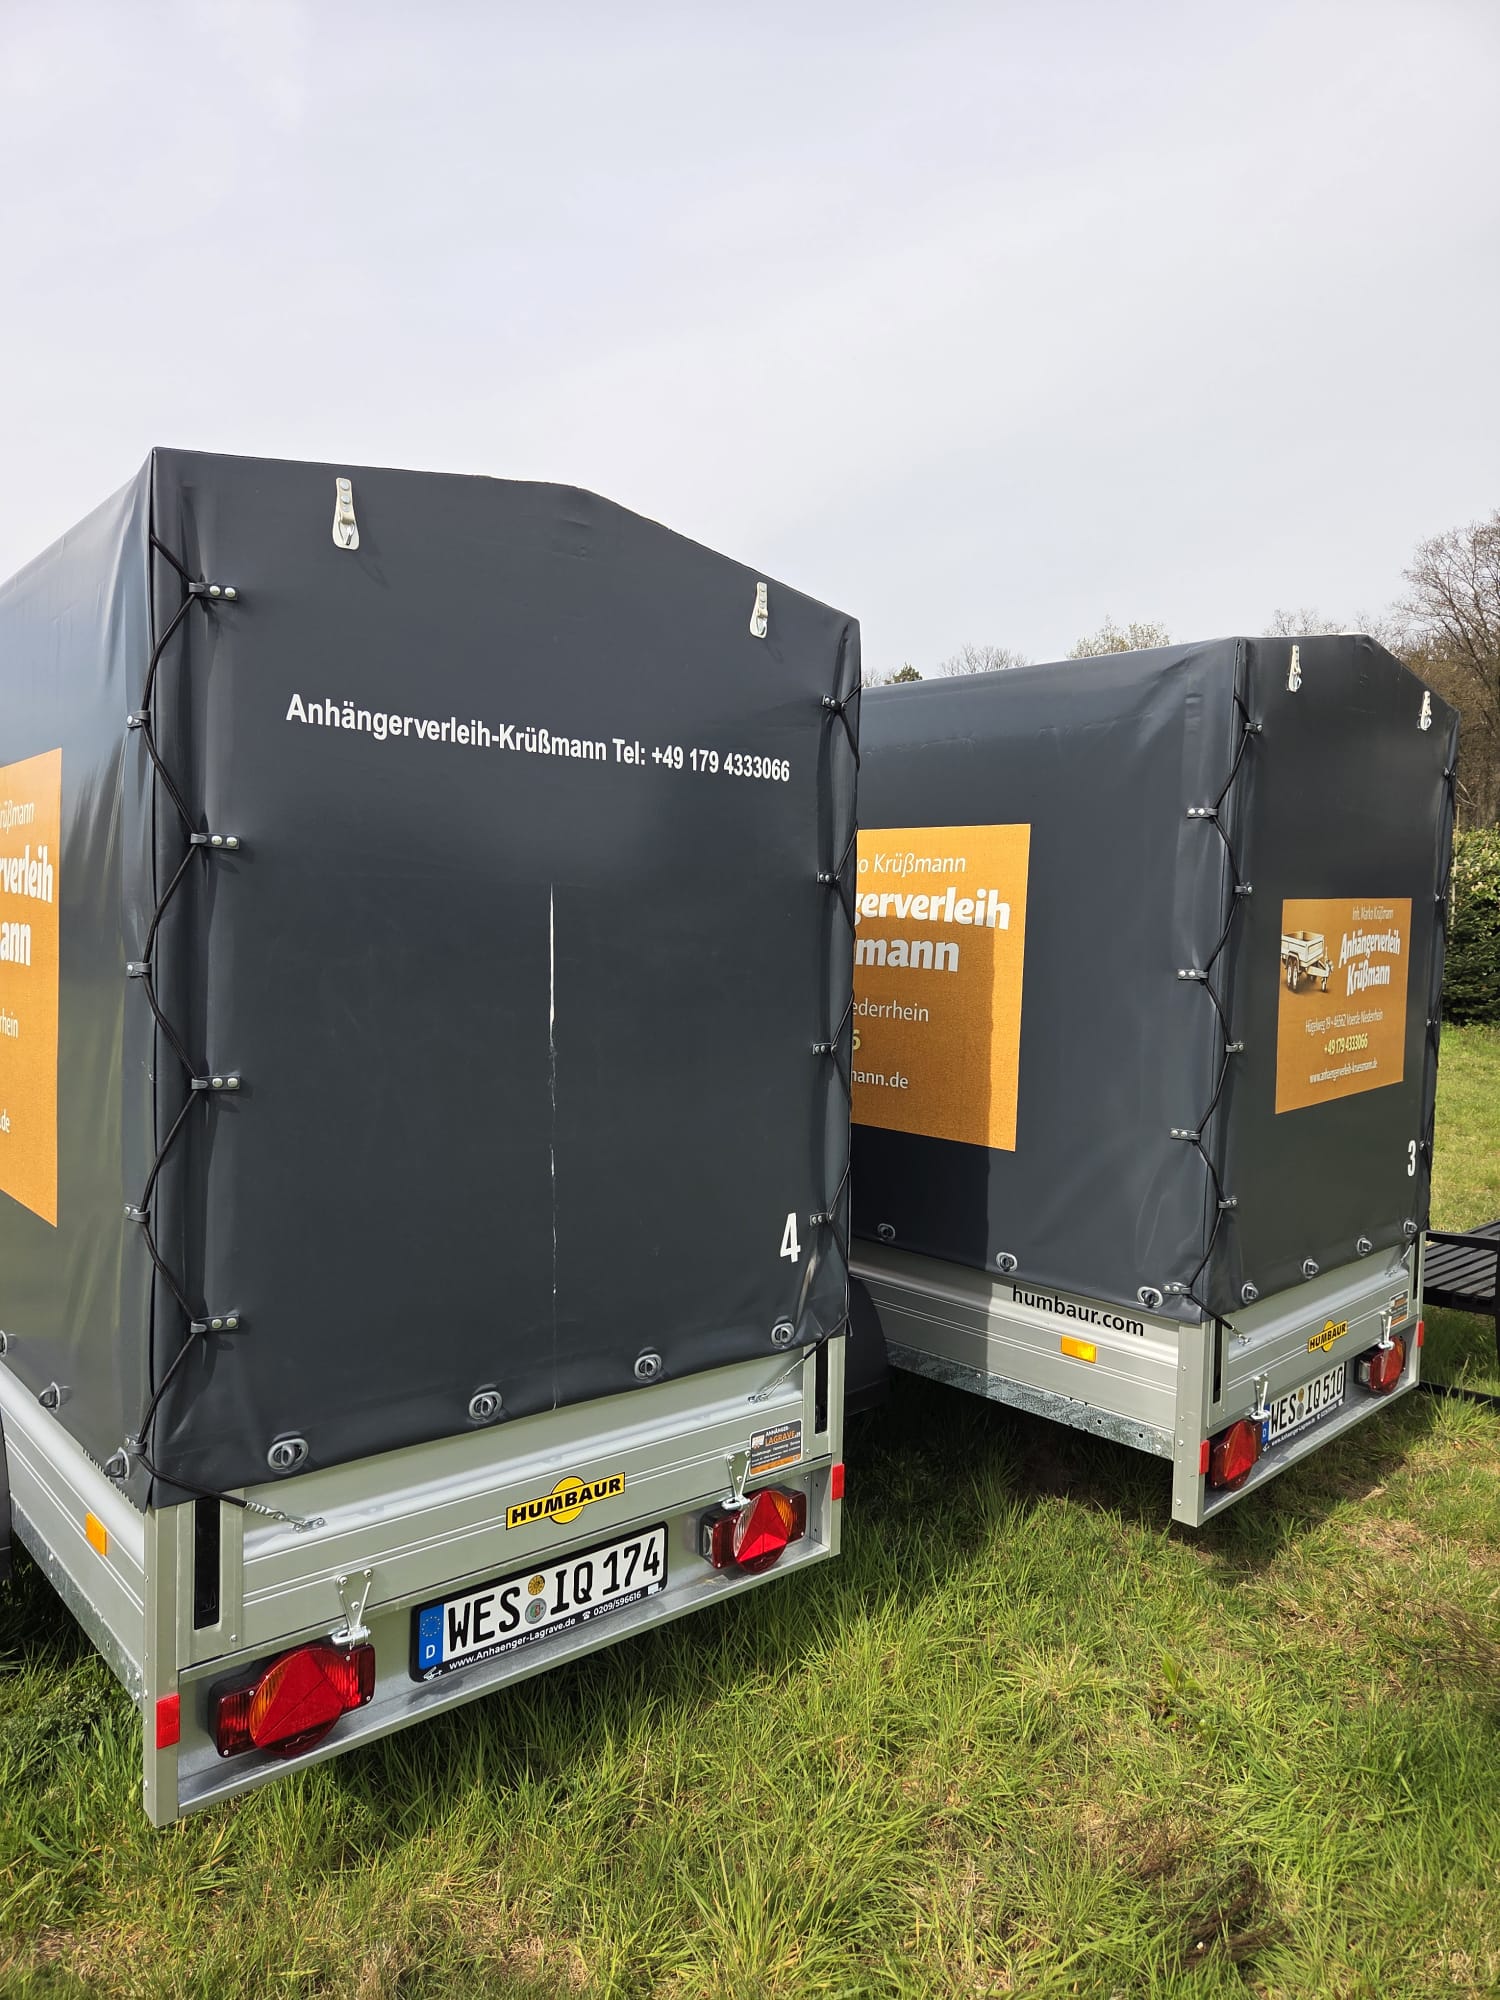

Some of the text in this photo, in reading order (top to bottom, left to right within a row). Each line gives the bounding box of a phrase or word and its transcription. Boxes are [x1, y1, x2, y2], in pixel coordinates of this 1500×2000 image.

[286, 693, 790, 782] Anhängerverleih-Krüßmann Tel: +49 179 4333066
[873, 852, 967, 878] Krüßmann
[1338, 928, 1401, 969] Anhängerverleih
[1346, 959, 1391, 997] Krüßmann
[1345, 1033, 1368, 1052] 4333066
[1407, 1139, 1417, 1177] 3
[780, 1212, 802, 1263] 4
[1012, 1284, 1144, 1337] humbaur.com
[1309, 1323, 1347, 1350] HUMBAUR
[1271, 1366, 1343, 1435] WES IQ 510
[511, 1477, 622, 1525] HUMBAUR
[447, 1536, 660, 1653] WES IQ 174
[425, 1644, 436, 1660] D
[449, 1590, 642, 1671] www.Anhaenger-Lagrave.de 0209/596616
